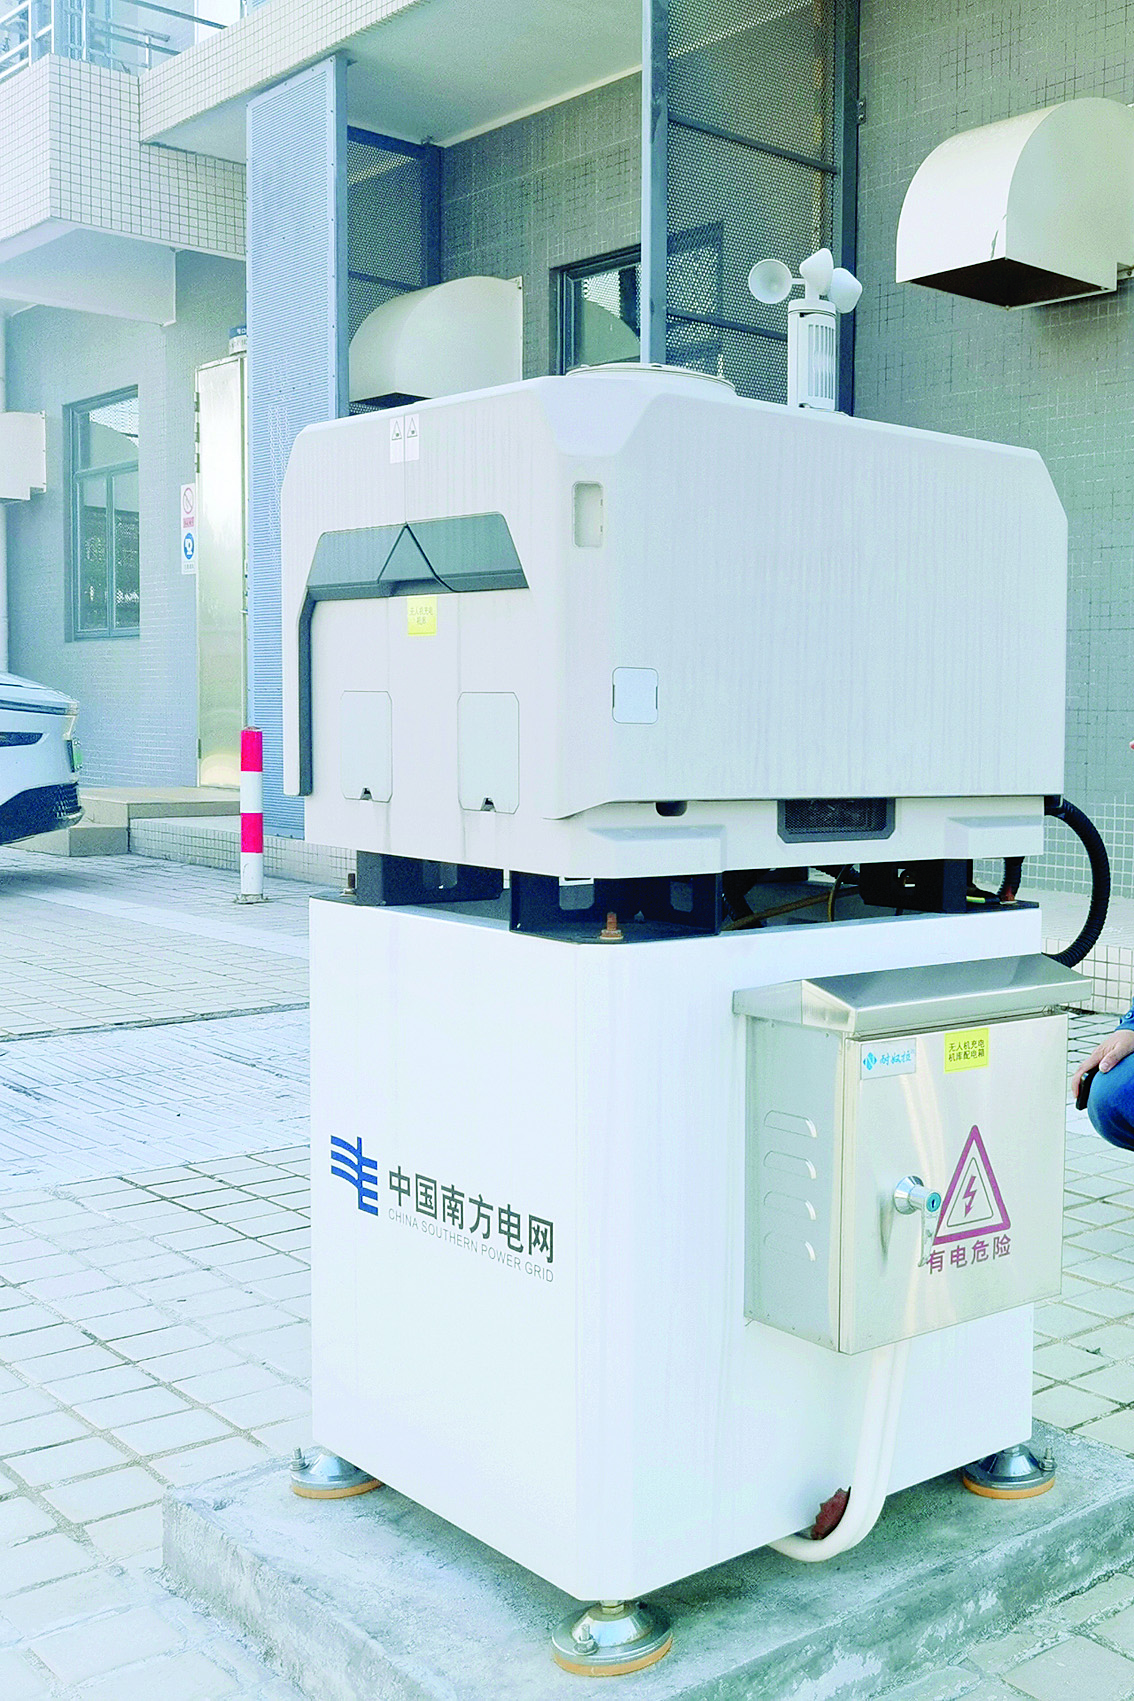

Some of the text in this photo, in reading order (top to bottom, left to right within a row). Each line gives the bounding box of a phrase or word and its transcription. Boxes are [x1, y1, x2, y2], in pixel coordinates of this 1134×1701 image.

[948, 1039, 985, 1052] 无人机充电
[948, 1050, 985, 1062] 机库配电箱
[389, 1165, 554, 1263] 中国南方电网
[388, 1207, 554, 1283] CHINA SOUTHERN POWER GRID
[926, 1233, 1011, 1275] 有电危险
